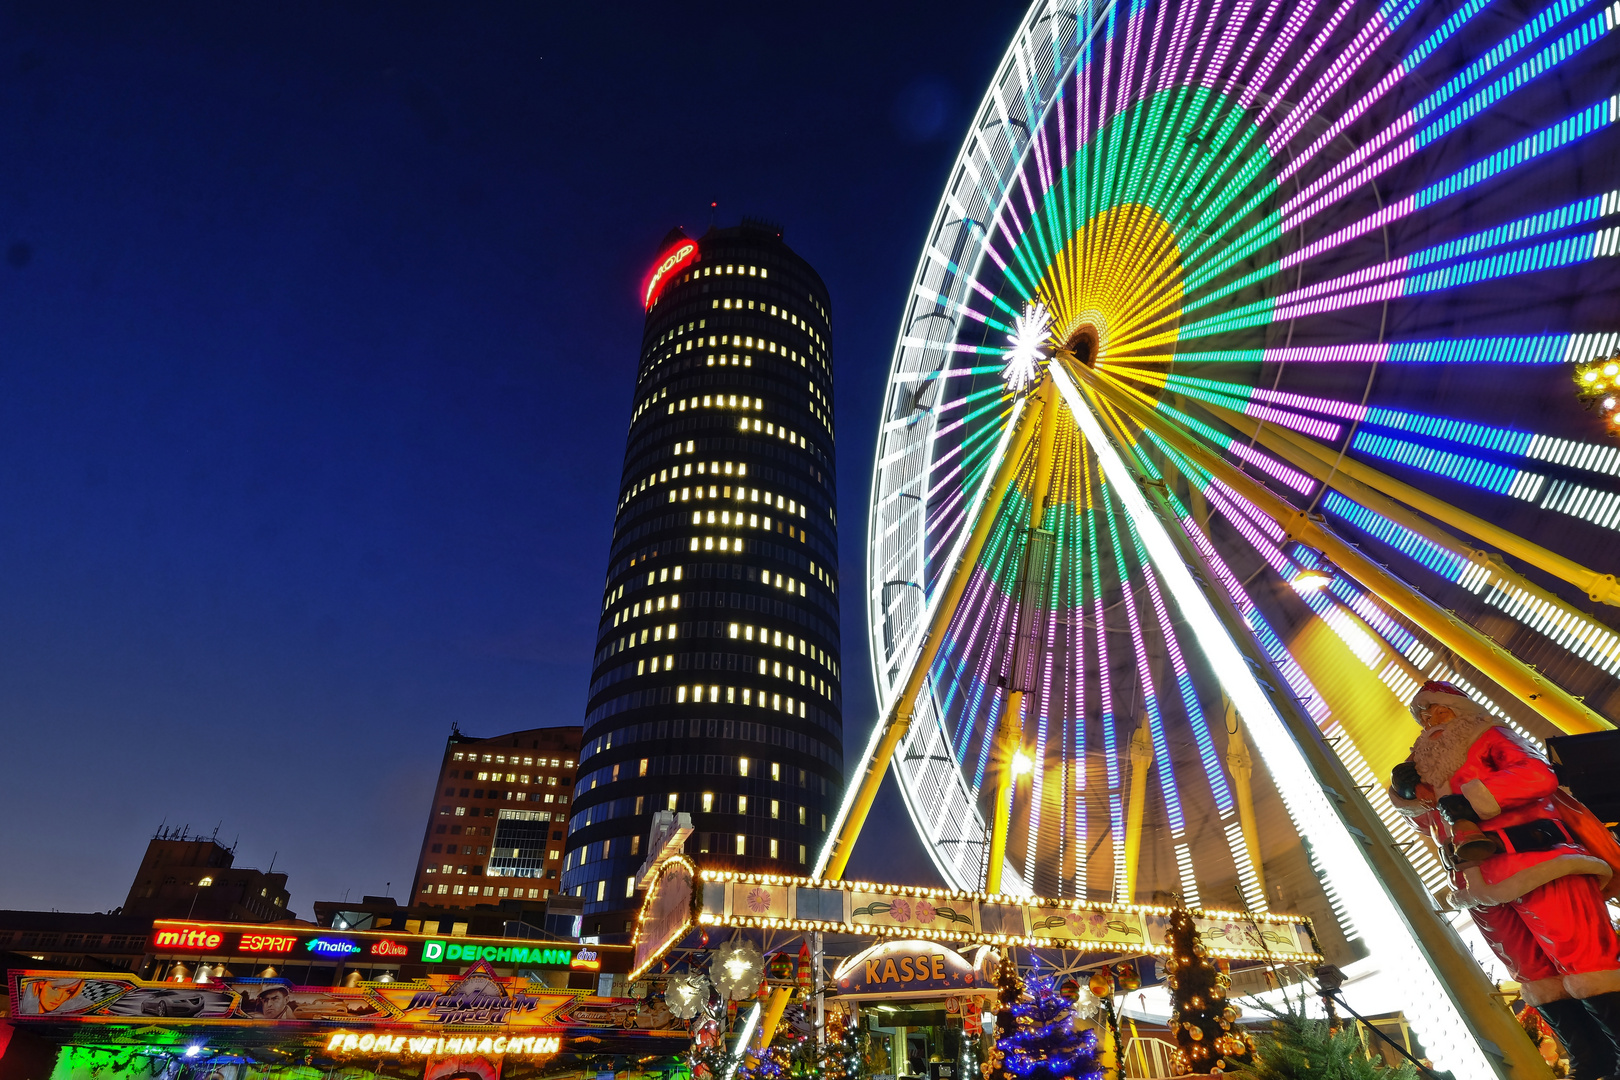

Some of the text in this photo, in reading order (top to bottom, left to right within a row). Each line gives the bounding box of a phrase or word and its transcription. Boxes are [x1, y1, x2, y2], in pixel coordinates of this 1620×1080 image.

[156, 929, 221, 947] mitte
[239, 935, 297, 952] ESPRIT
[371, 940, 407, 955] s.Oliver
[446, 943, 572, 965] DEICHMANN
[576, 948, 598, 961] dm
[865, 954, 946, 984] KASSE
[420, 1006, 511, 1025] Speed
